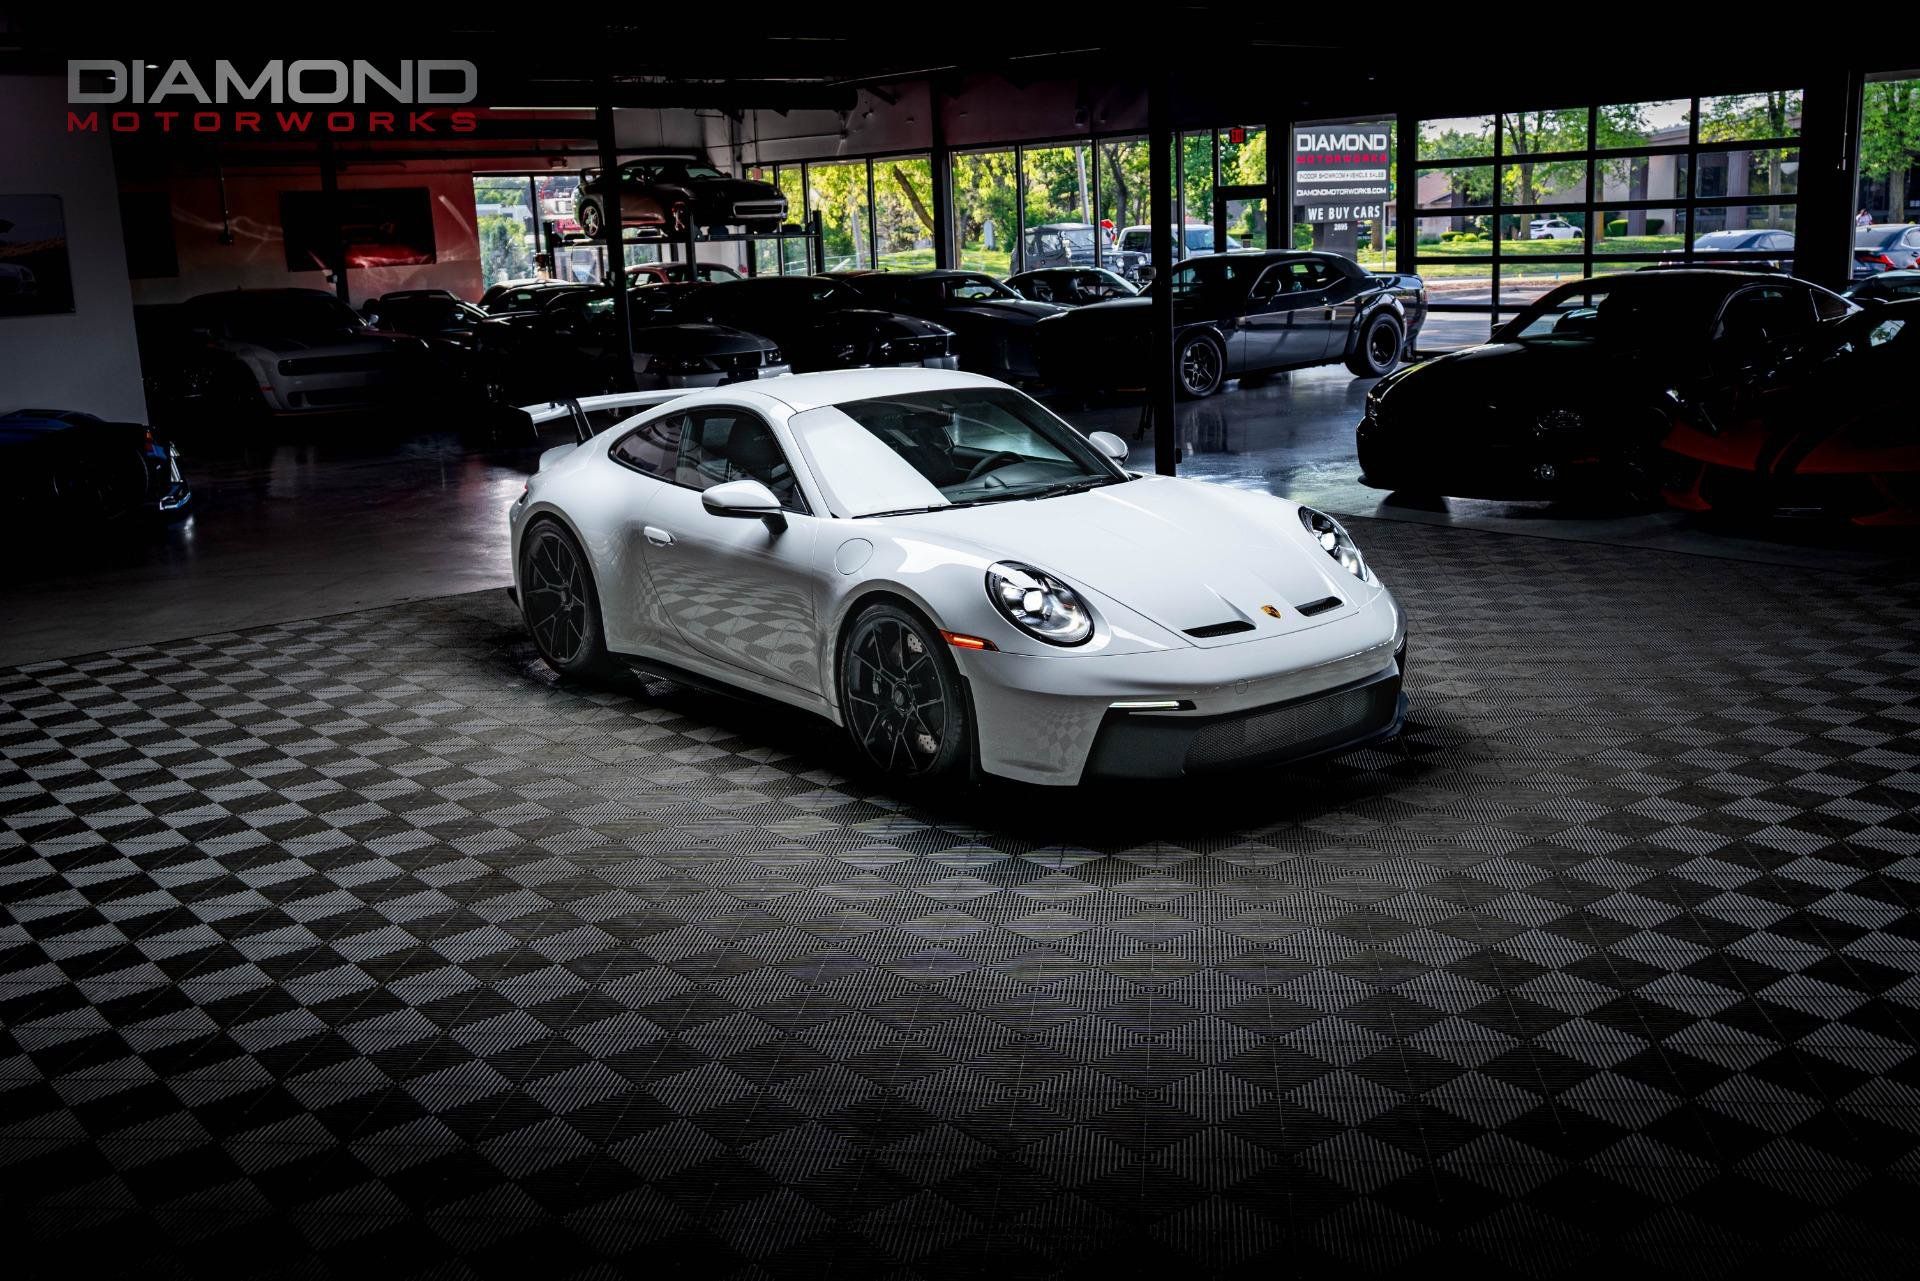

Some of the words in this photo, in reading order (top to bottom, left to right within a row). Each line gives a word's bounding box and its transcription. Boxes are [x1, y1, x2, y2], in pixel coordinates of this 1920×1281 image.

[1296, 133, 1387, 151] DIAMOND
[1296, 154, 1387, 164] MOTORWORKS
[1296, 187, 1387, 196] DIAMONDMOTORWORKS.COM
[1307, 208, 1324, 221] WE
[1328, 207, 1349, 220] BUY
[1353, 205, 1380, 219] CARS
